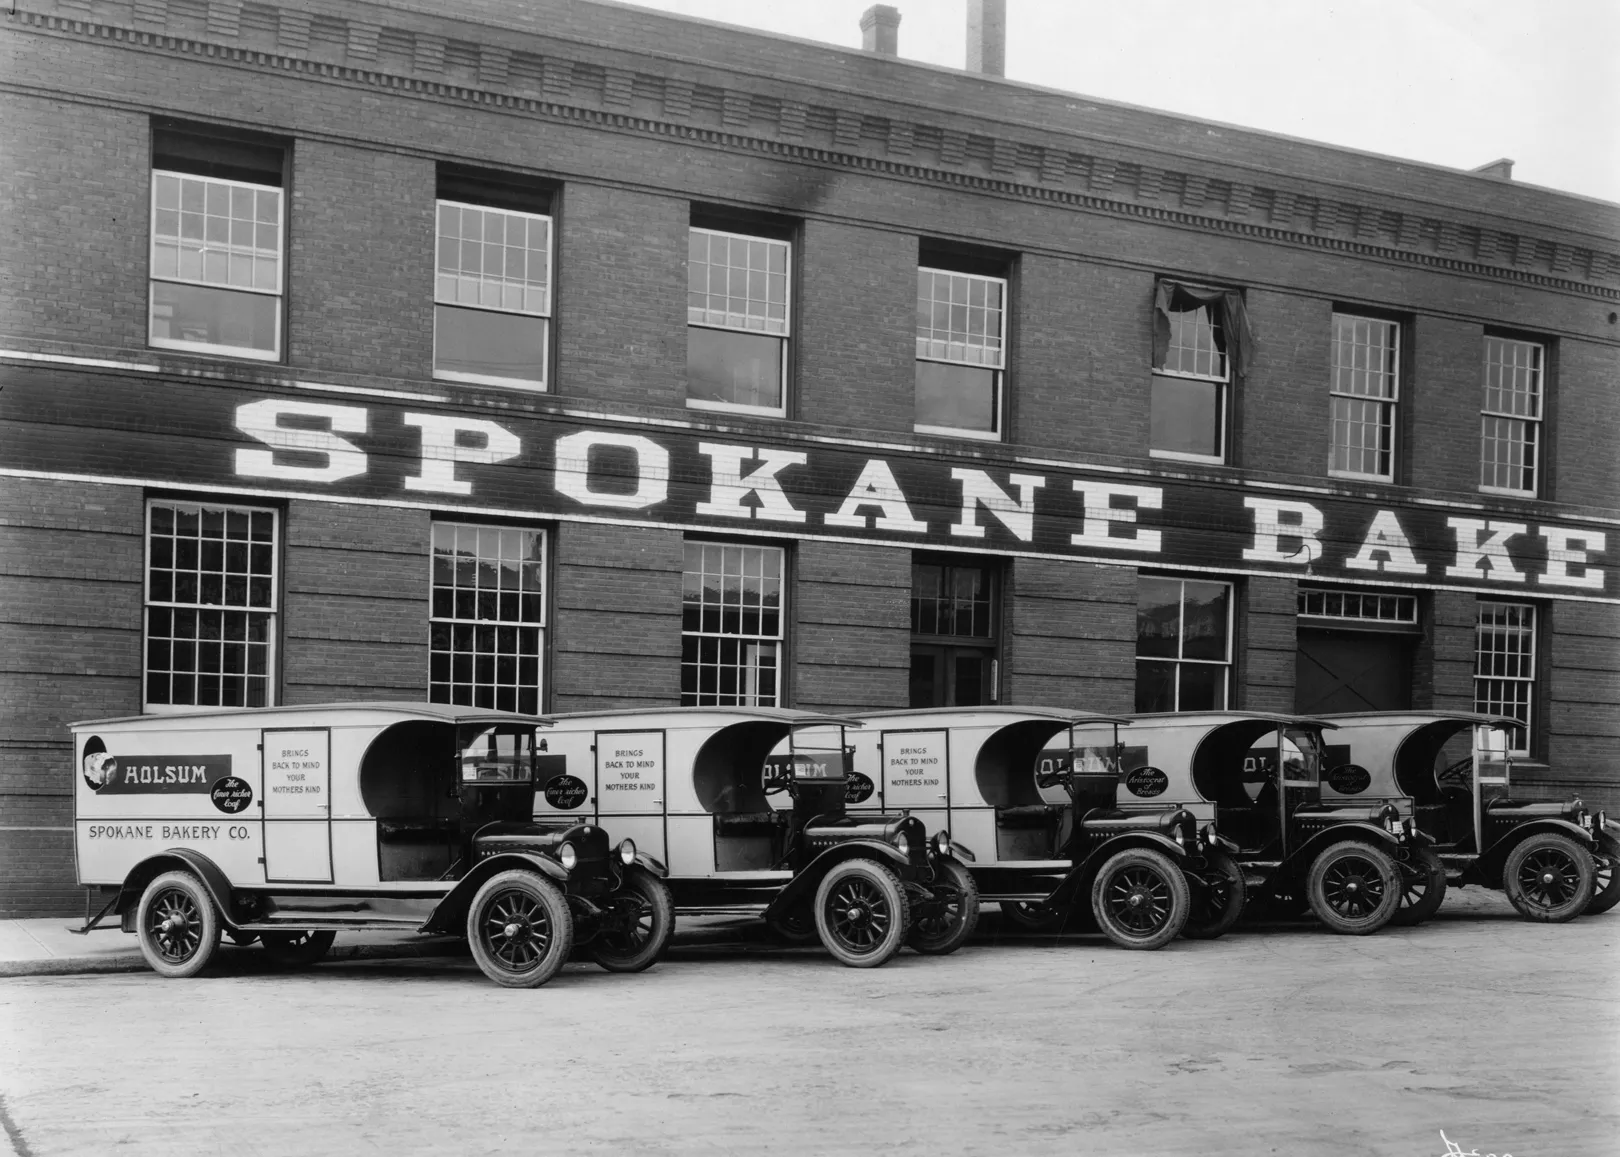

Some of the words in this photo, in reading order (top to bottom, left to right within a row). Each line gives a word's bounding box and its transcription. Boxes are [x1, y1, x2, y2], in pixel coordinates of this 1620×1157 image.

[235, 398, 1163, 552] SPOKANE
[1242, 496, 1606, 589] BAKE
[281, 749, 309, 757] BRINGS
[272, 761, 290, 770] BACK
[292, 761, 300, 769] TO
[302, 761, 320, 769] MIND
[605, 761, 624, 769] BACK
[890, 758, 910, 766] BACK
[920, 757, 938, 765] MIND
[124, 765, 207, 784] HOLSUM
[905, 768, 924, 776] YOUR
[225, 778, 239, 788] The
[605, 783, 638, 791] MOTHERS
[639, 783, 656, 791] KIND
[891, 779, 922, 787] MOTHERS
[923, 778, 939, 786] KIND
[305, 785, 321, 793] KIND
[89, 825, 153, 839] SPOKANE
[162, 825, 220, 839] BAKERY
[228, 826, 250, 839] CO.
